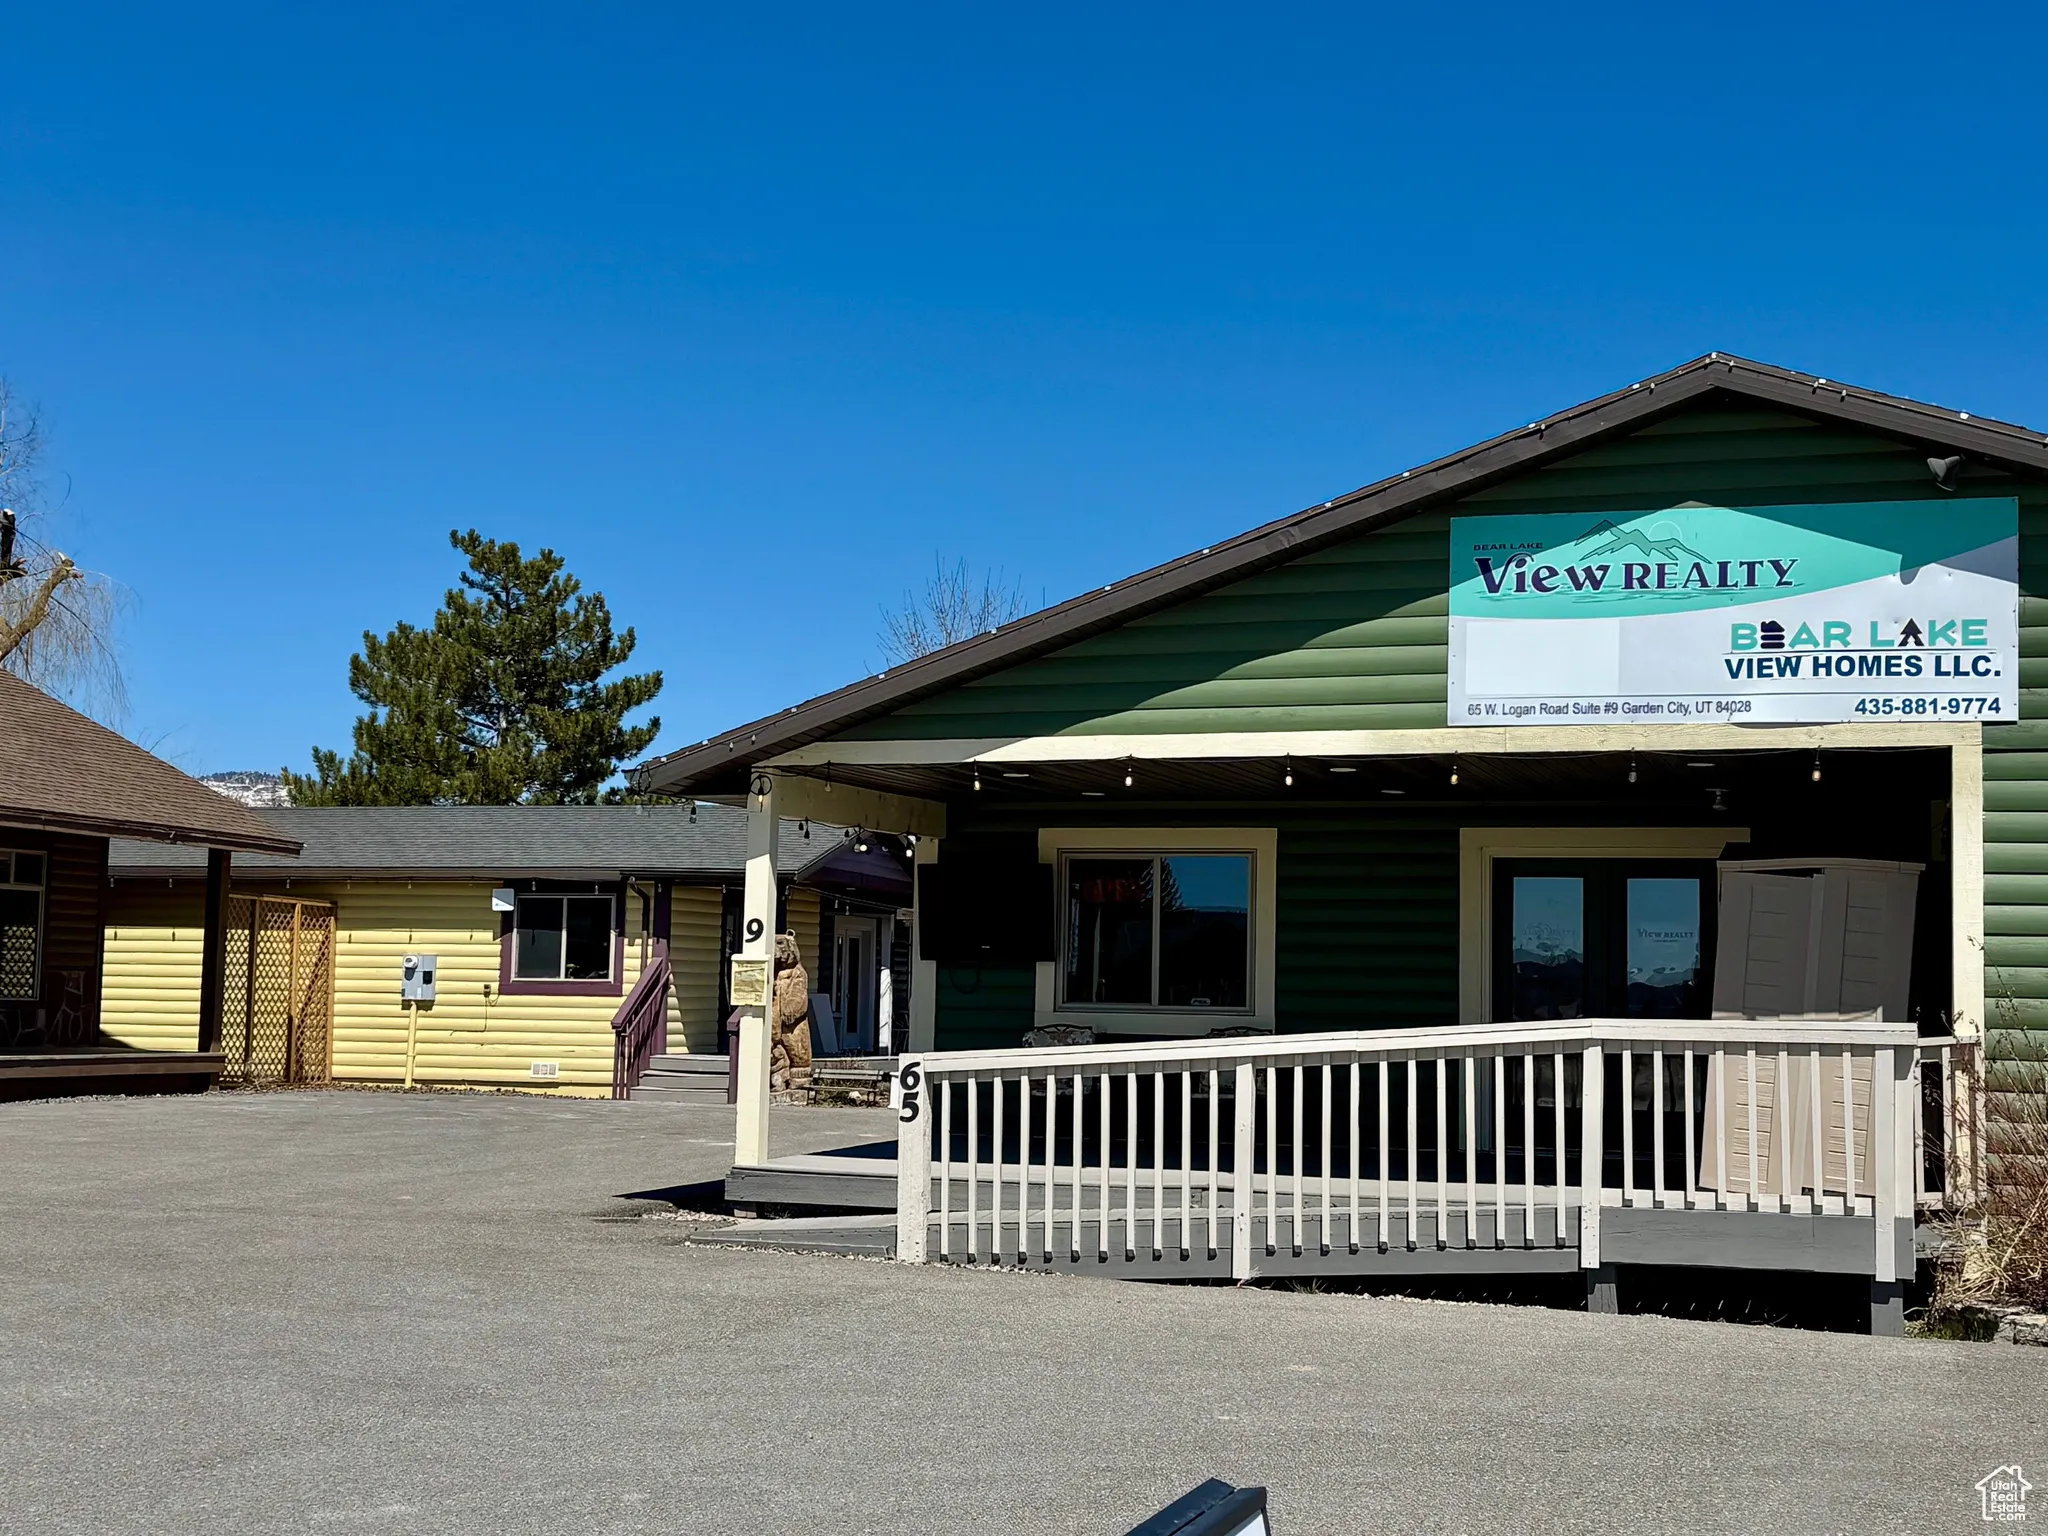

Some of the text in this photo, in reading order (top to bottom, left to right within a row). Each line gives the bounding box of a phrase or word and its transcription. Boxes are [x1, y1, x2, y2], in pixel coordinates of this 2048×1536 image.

[1473, 542, 1543, 551] BEAR LAKE
[1474, 552, 1799, 594] View REALTY
[1731, 617, 1988, 651] BEAR LAKE
[1725, 654, 2001, 680] VIEW HOMES LLC.
[1467, 700, 1752, 718] 65 W. Logan Road Suite #9 Garden City, UT 84028
[1854, 697, 2001, 716] 435-881-9774
[745, 918, 764, 943] 9
